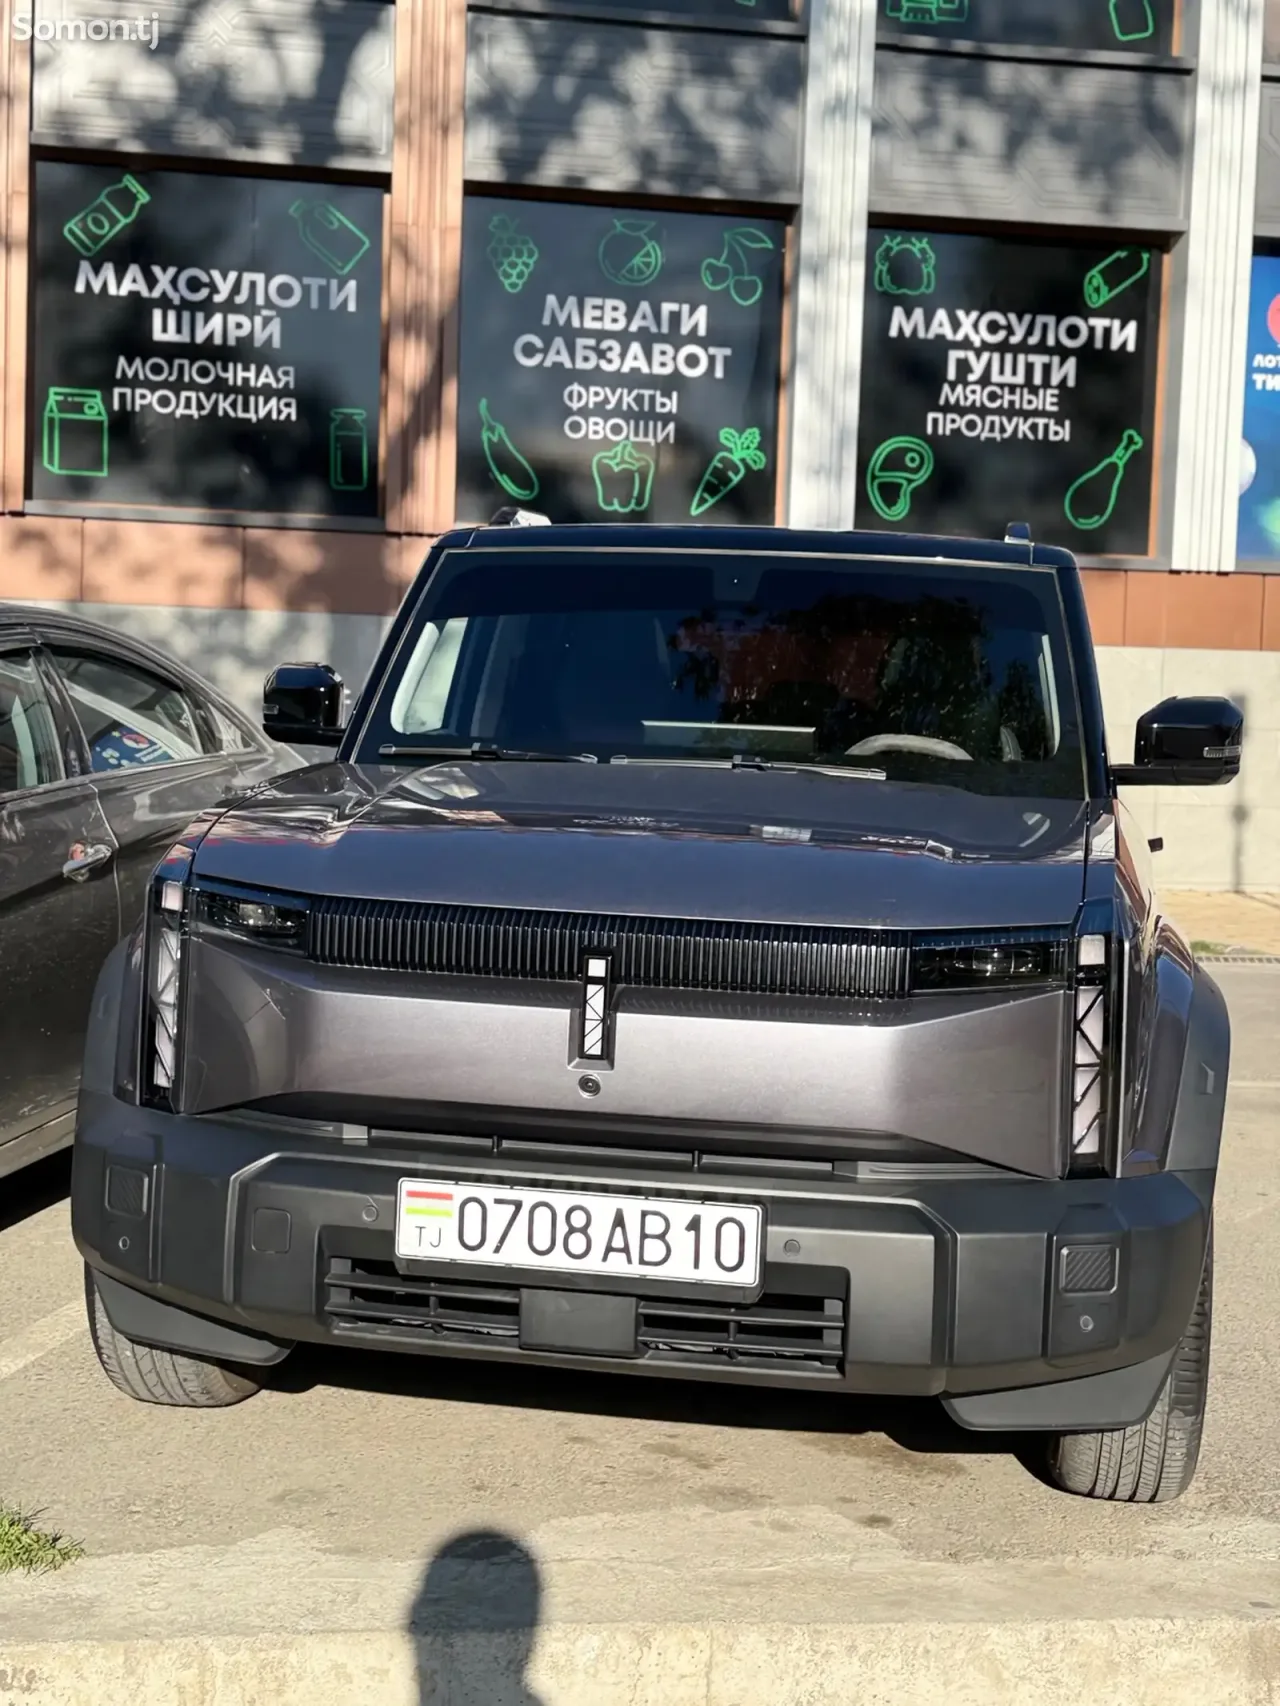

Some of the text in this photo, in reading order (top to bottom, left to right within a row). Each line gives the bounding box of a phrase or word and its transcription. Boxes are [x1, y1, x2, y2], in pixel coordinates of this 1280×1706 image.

[74, 260, 358, 312] МАҲСУЛОТИ
[152, 308, 281, 348] ШИРӢ
[541, 294, 708, 336] МЕВАГИ
[888, 306, 1138, 352] МАҲСУЛОТИ
[115, 355, 296, 389] МОЛОЧНАЯ
[513, 333, 732, 378] САБЗАВОТ
[946, 349, 1077, 388] ГУШТИ
[112, 387, 297, 423] ПРОДУКЦИЯ
[563, 382, 678, 414] ФРУКТЫ
[939, 383, 1060, 411] МЯСНЫЕ
[563, 415, 675, 446] ОВОЩИ
[926, 412, 1071, 442] ПРОДУКТЫ
[414, 1225, 442, 1248] TJ
